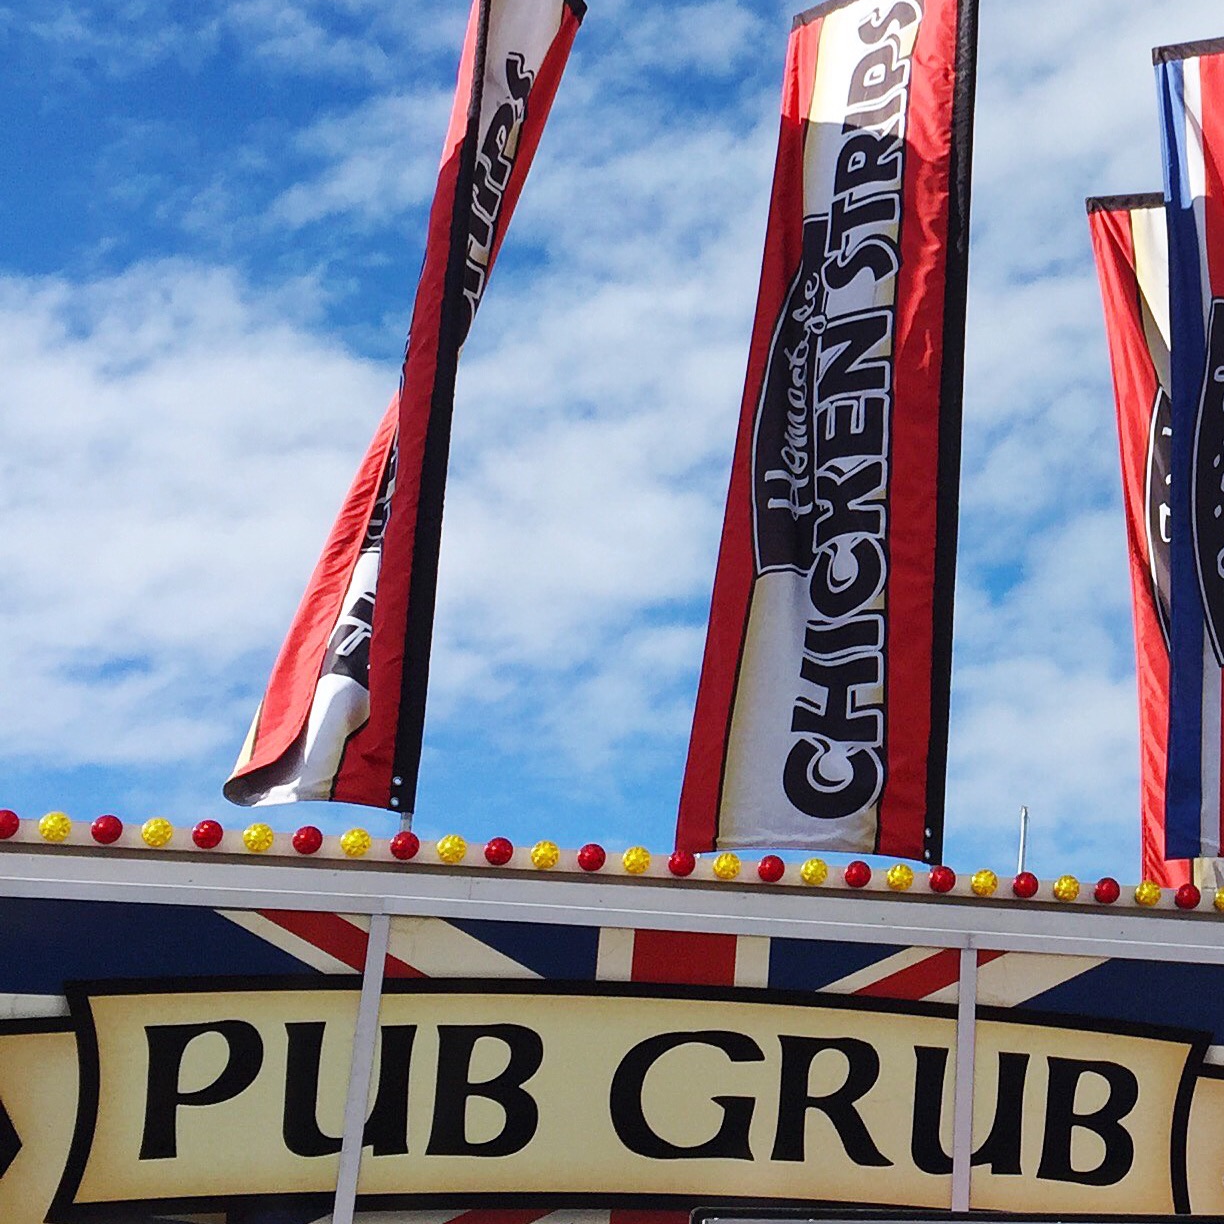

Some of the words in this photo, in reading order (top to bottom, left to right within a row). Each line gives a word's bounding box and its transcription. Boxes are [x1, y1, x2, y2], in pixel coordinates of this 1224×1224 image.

[764, 272, 828, 520] Homestyle
[783, 309, 892, 819] CHICKEN
[138, 1019, 544, 1161] PUB
[609, 1030, 1140, 1187] GRUB
